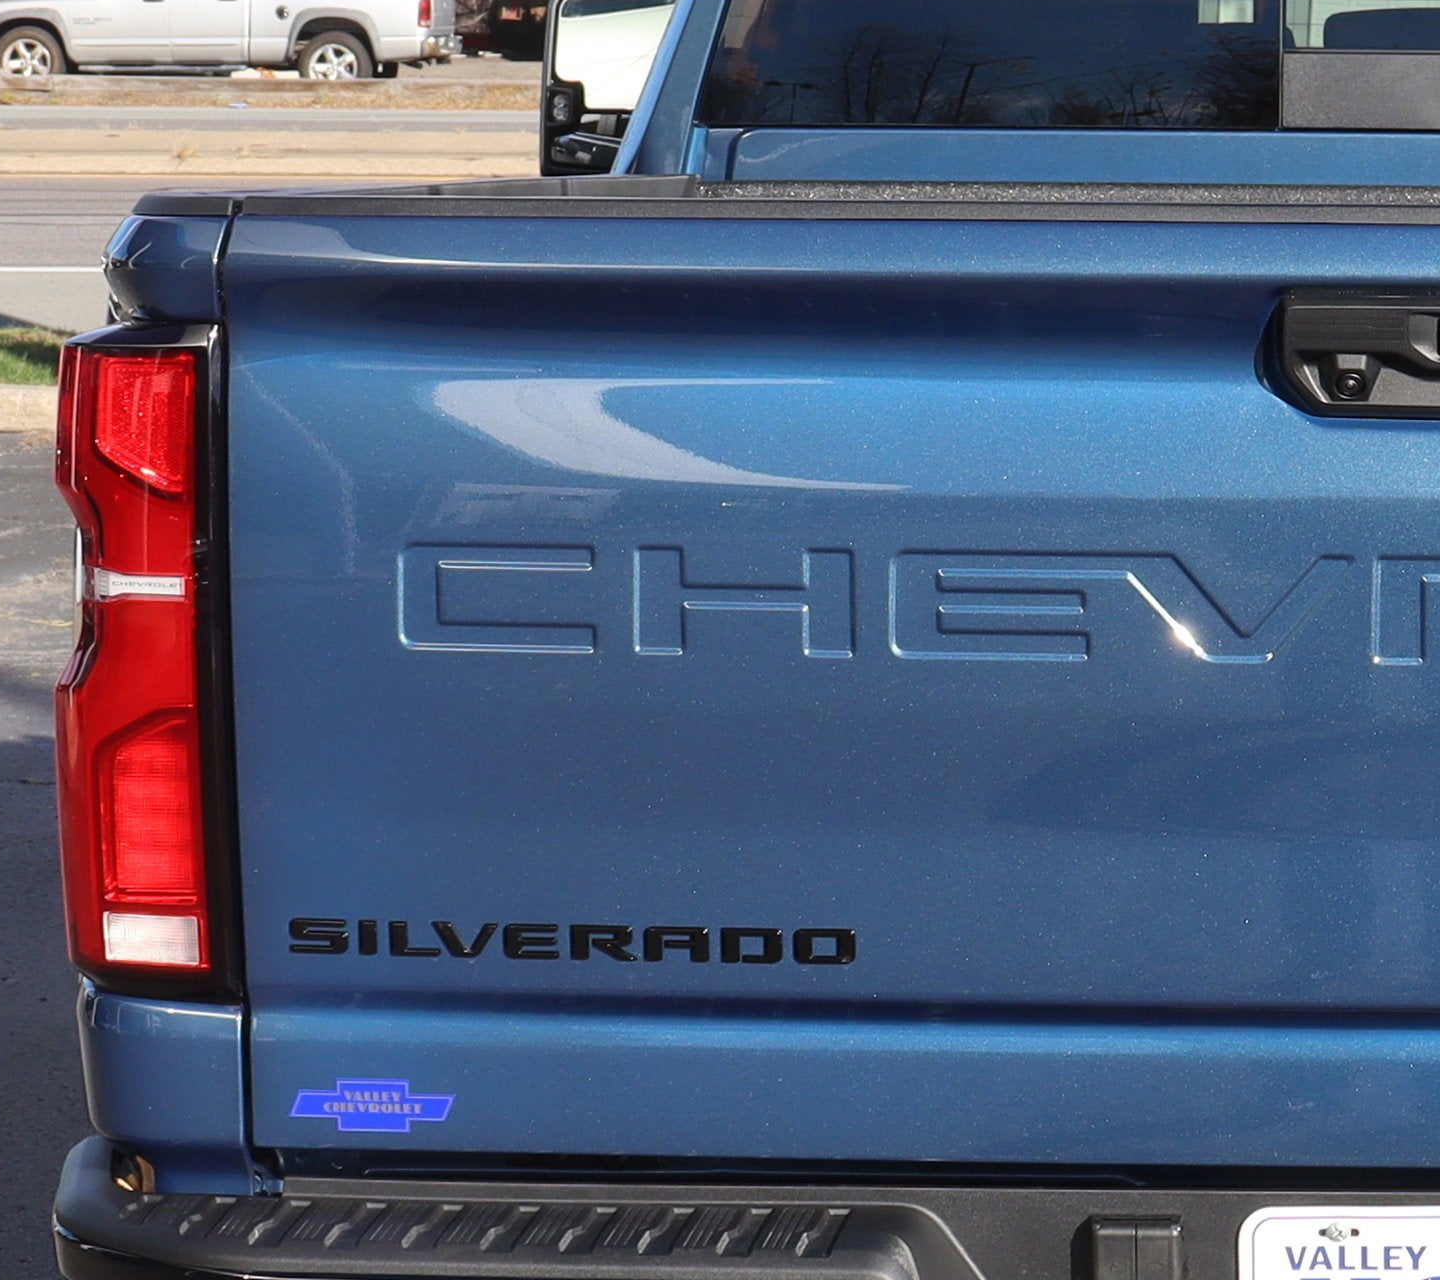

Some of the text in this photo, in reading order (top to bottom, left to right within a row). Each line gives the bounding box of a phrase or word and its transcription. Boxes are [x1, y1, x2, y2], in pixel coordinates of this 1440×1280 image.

[288, 917, 858, 966] SILVERADO
[343, 1090, 402, 1102] VALLEY
[323, 1101, 423, 1114] CHEVROLET
[1285, 1245, 1427, 1271] VALLEY
